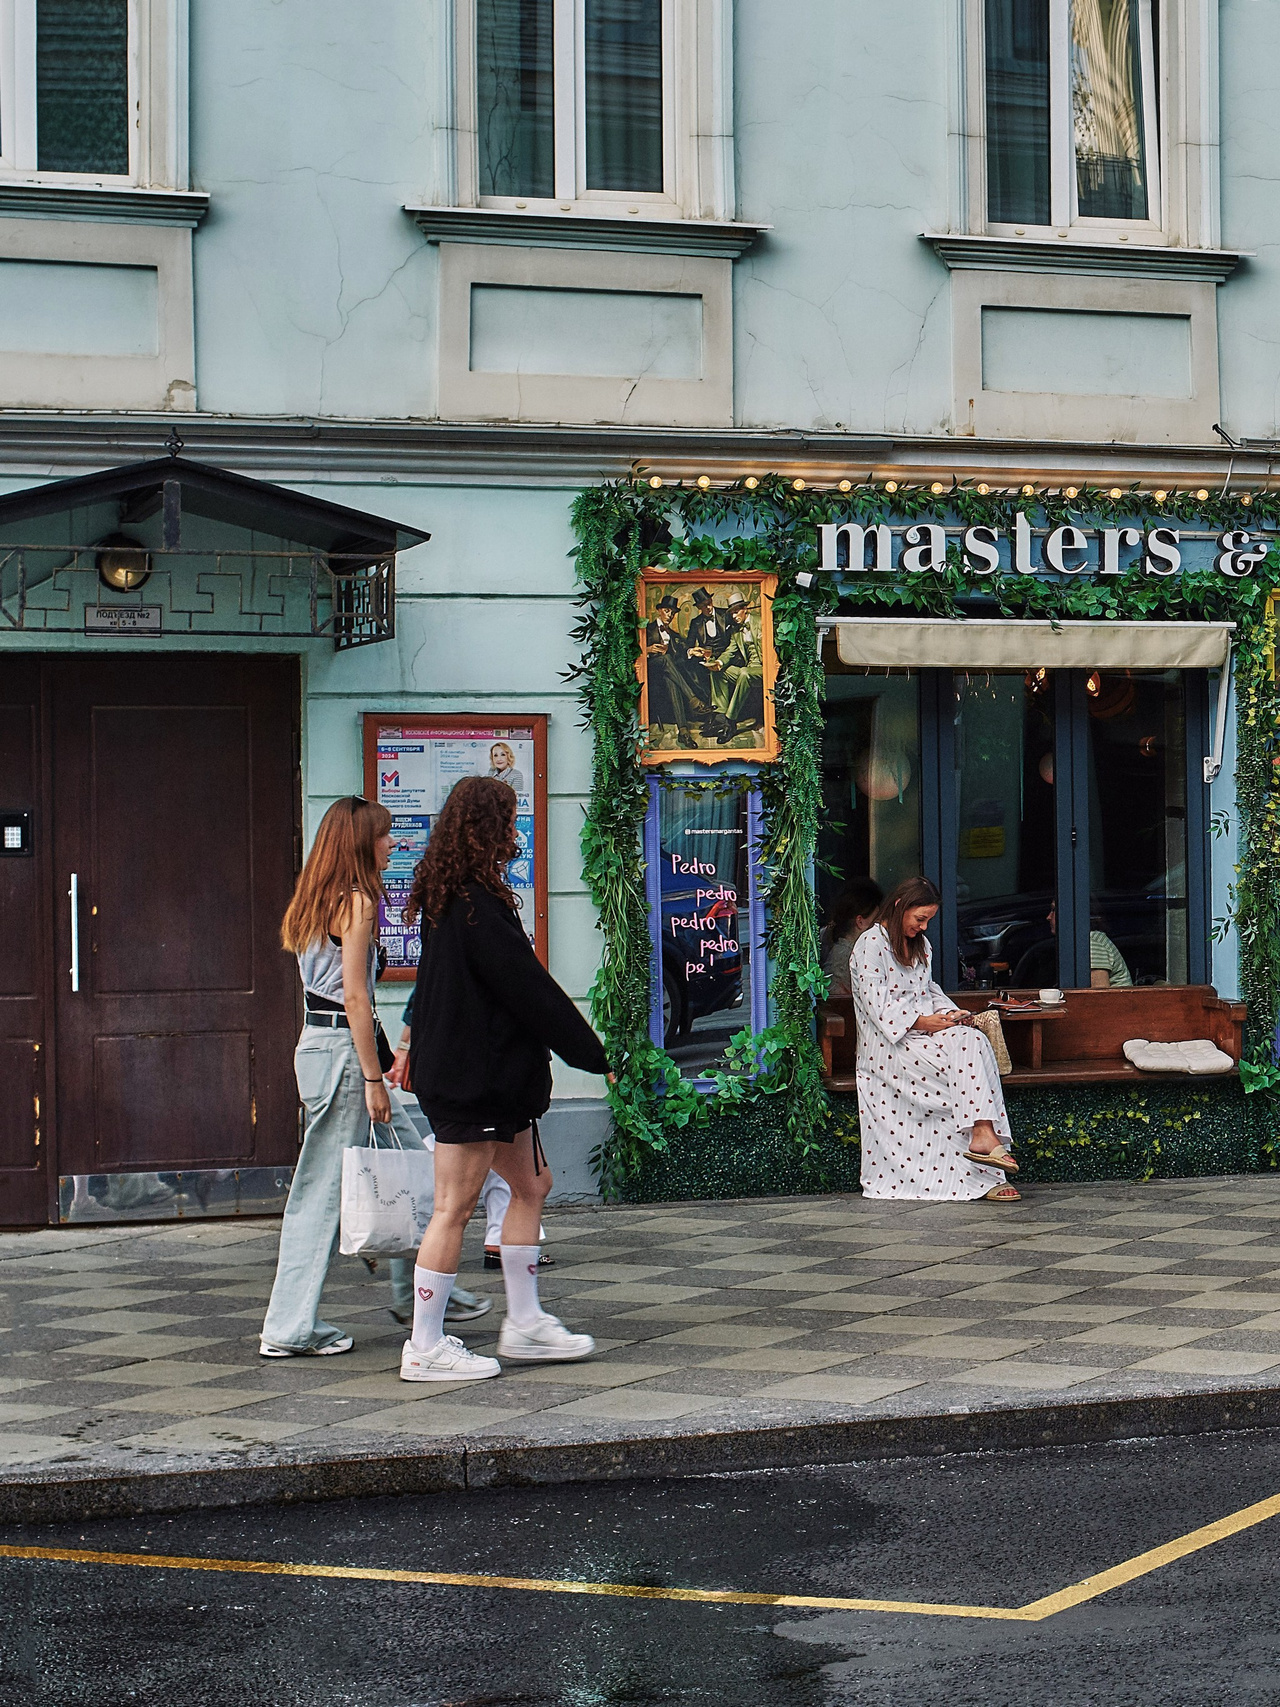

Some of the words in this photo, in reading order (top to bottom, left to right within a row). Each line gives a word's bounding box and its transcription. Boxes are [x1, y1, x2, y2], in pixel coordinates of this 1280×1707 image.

[816, 511, 1182, 576] masters
[1216, 529, 1268, 577] &
[137, 611, 151, 619] №2
[672, 854, 716, 875] Pedro
[696, 884, 737, 908] pedro
[671, 912, 716, 938] pedro
[700, 935, 739, 957] pedro
[380, 1198, 397, 1207] SLOW
